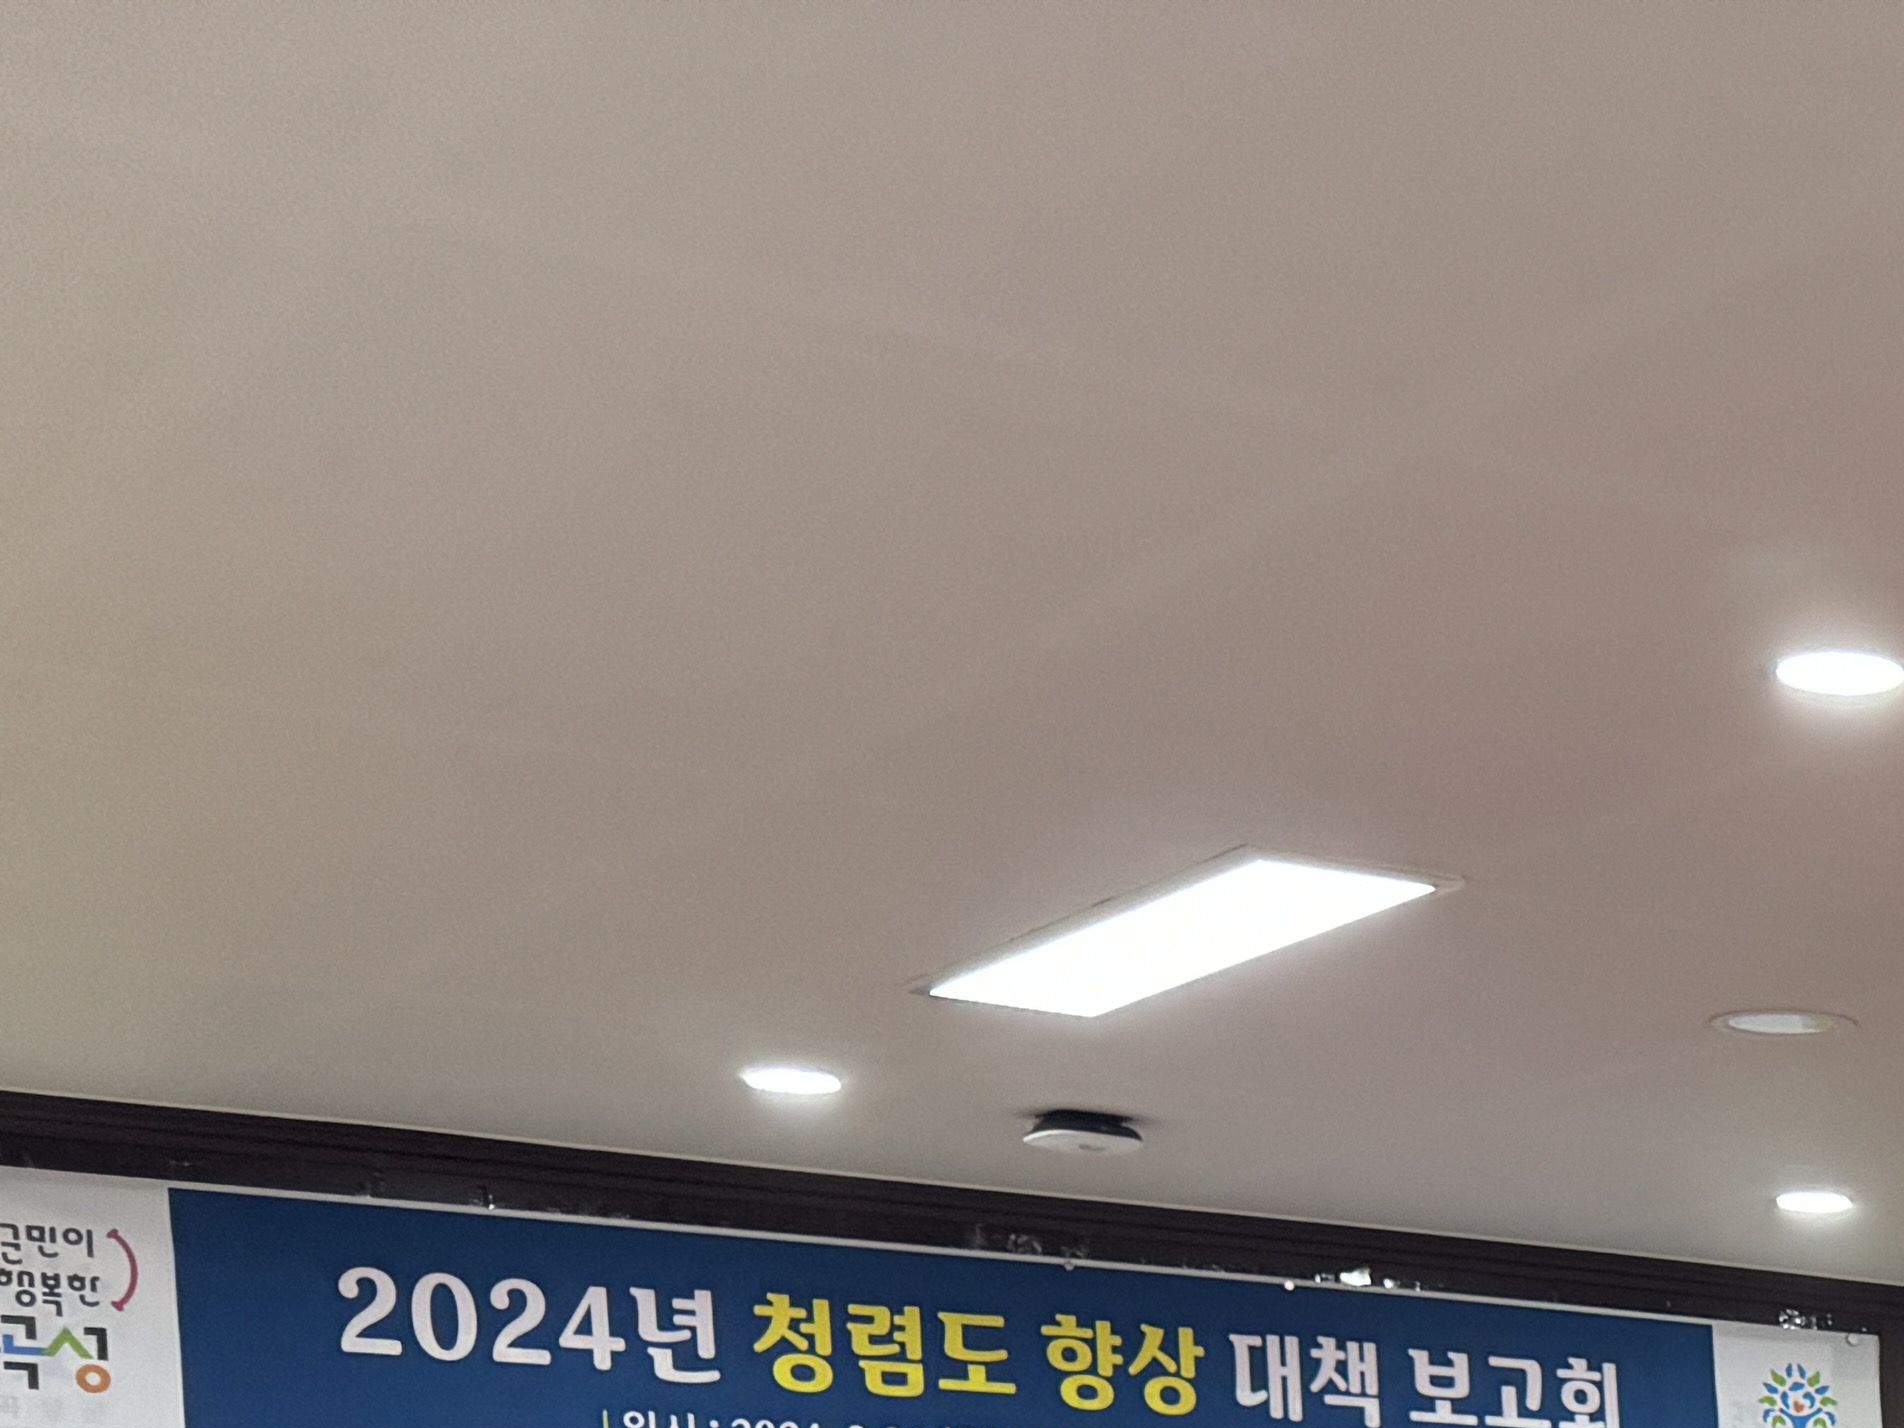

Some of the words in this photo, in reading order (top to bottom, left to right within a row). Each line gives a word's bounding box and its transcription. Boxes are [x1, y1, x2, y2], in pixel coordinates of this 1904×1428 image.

[339, 1267, 720, 1383] 2024년
[754, 1293, 1016, 1397] 청렴도
[1041, 1315, 1204, 1415] 향상
[1229, 1334, 1380, 1428] 대책
